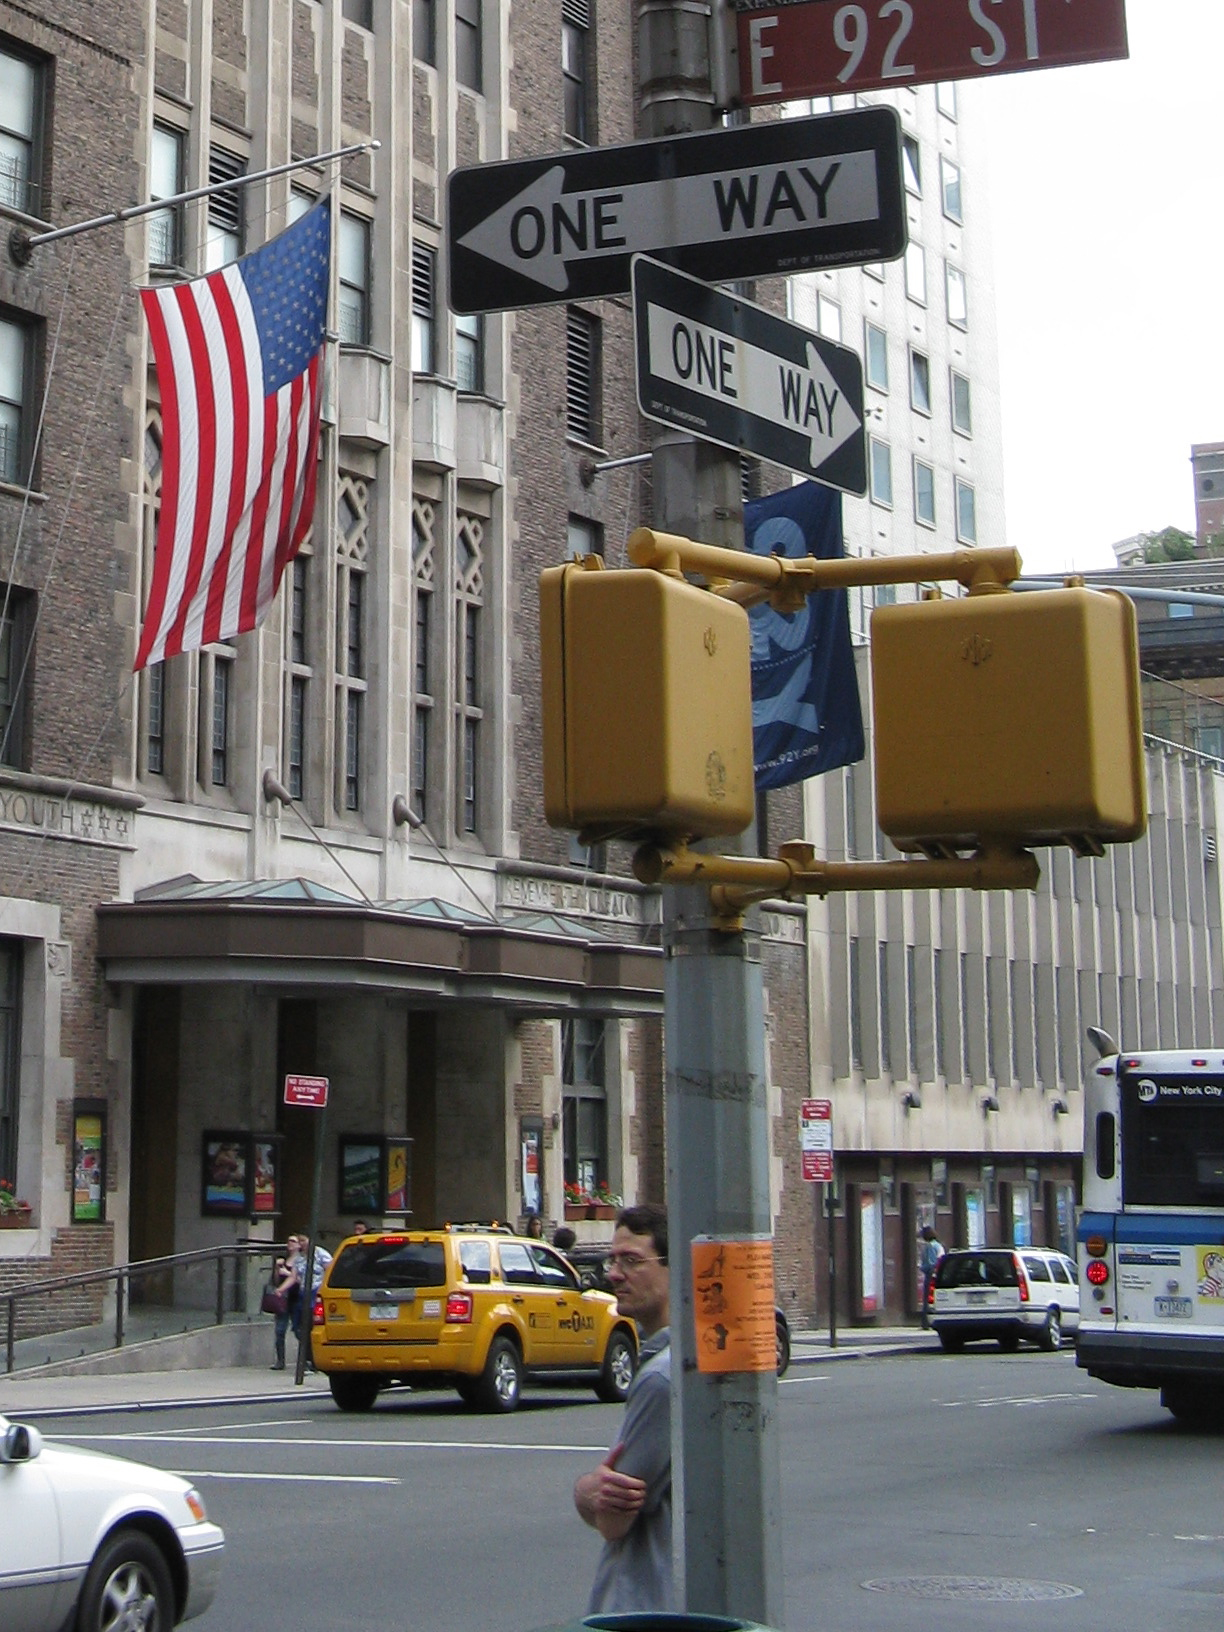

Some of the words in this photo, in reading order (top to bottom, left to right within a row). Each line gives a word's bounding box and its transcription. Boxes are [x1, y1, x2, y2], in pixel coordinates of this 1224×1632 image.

[749, 16, 782, 96] E
[833, 0, 916, 84] 92
[510, 194, 626, 259] ONE
[713, 162, 841, 232] WAY
[672, 322, 738, 399] ONE
[779, 365, 838, 438] WAY
[0, 791, 74, 833] YOUTH
[1160, 1086, 1180, 1095] New
[1182, 1086, 1203, 1095] York
[1204, 1085, 1223, 1097] City
